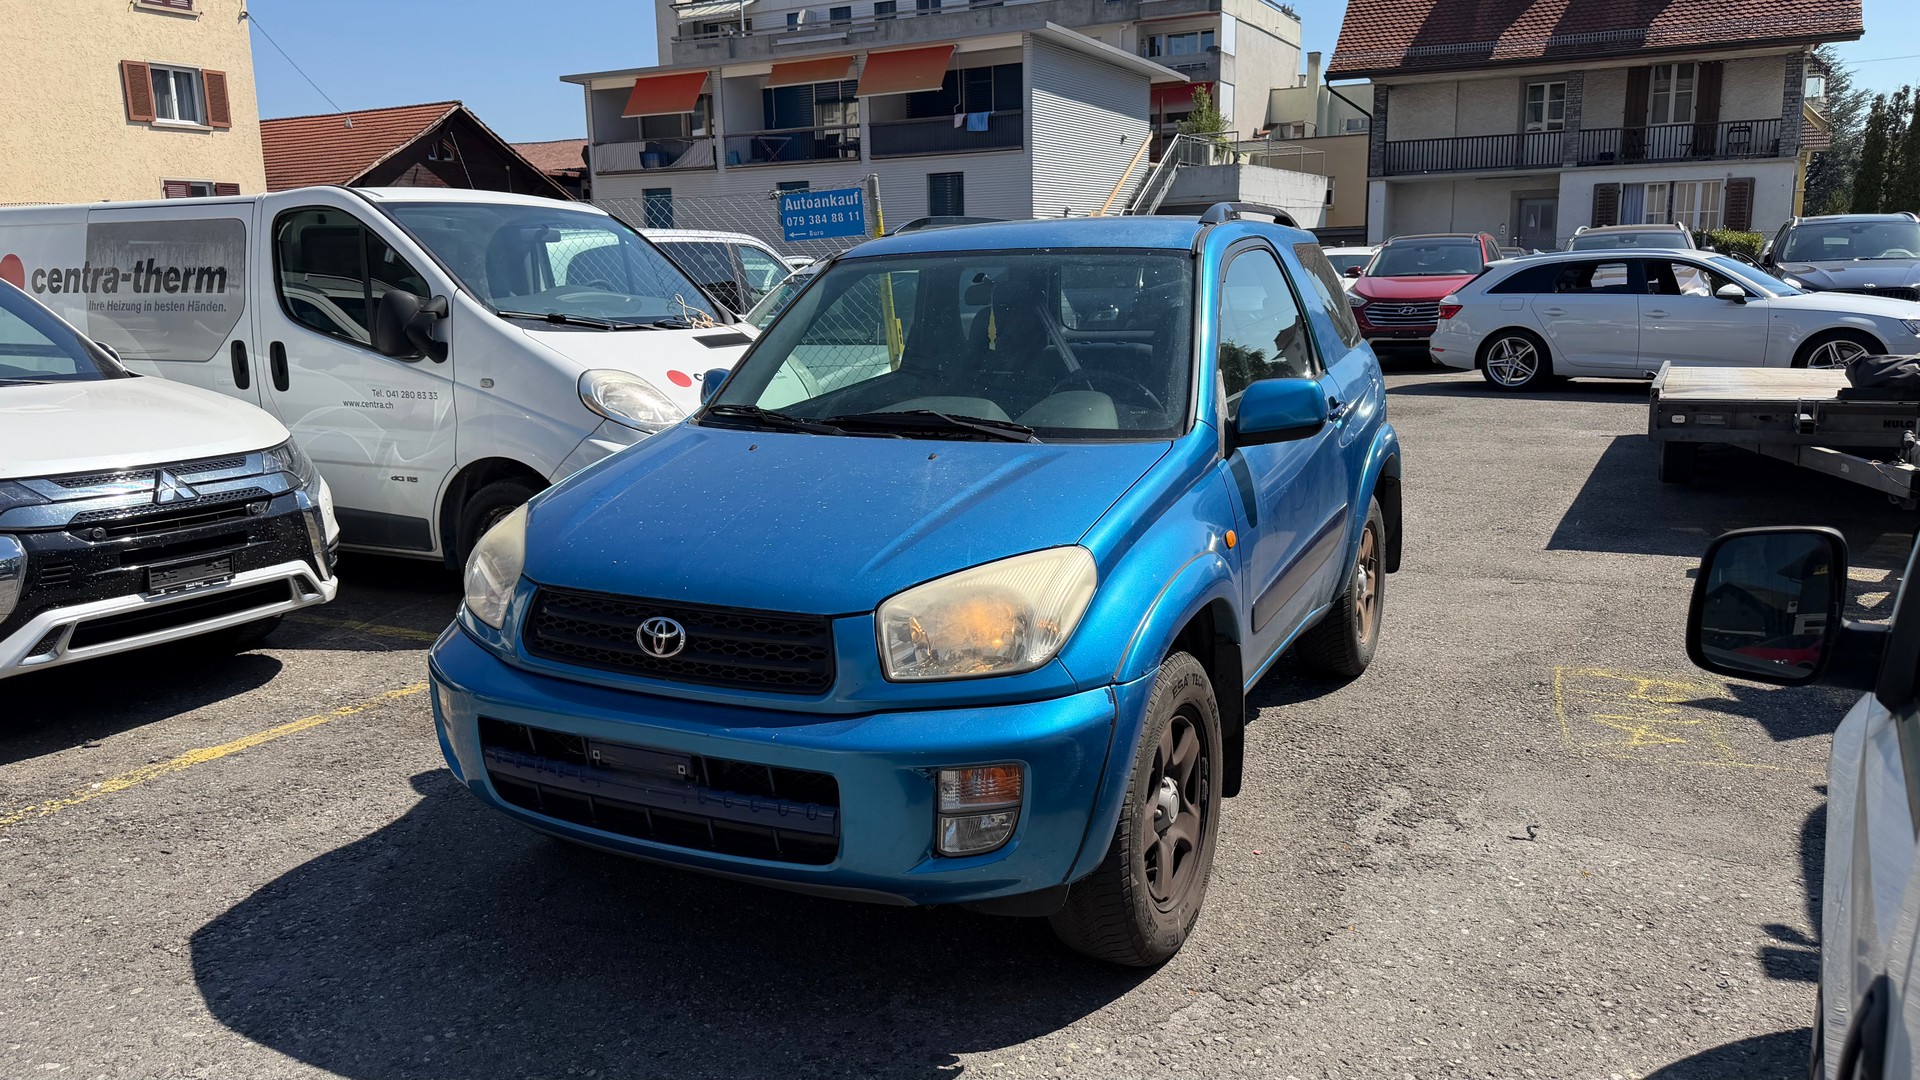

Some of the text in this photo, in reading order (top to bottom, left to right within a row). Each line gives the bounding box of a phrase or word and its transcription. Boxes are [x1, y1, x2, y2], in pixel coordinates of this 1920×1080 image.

[785, 192, 859, 211] Autoankauf
[786, 211, 860, 227] 079 384 88 11
[31, 258, 227, 294] centra-therm
[89, 300, 227, 314] Ihre Heizung in besten Händen.
[371, 389, 438, 400] Tel. 041 280 83 33
[342, 400, 394, 409] www.centra.ch
[1883, 419, 1915, 428] HULC
